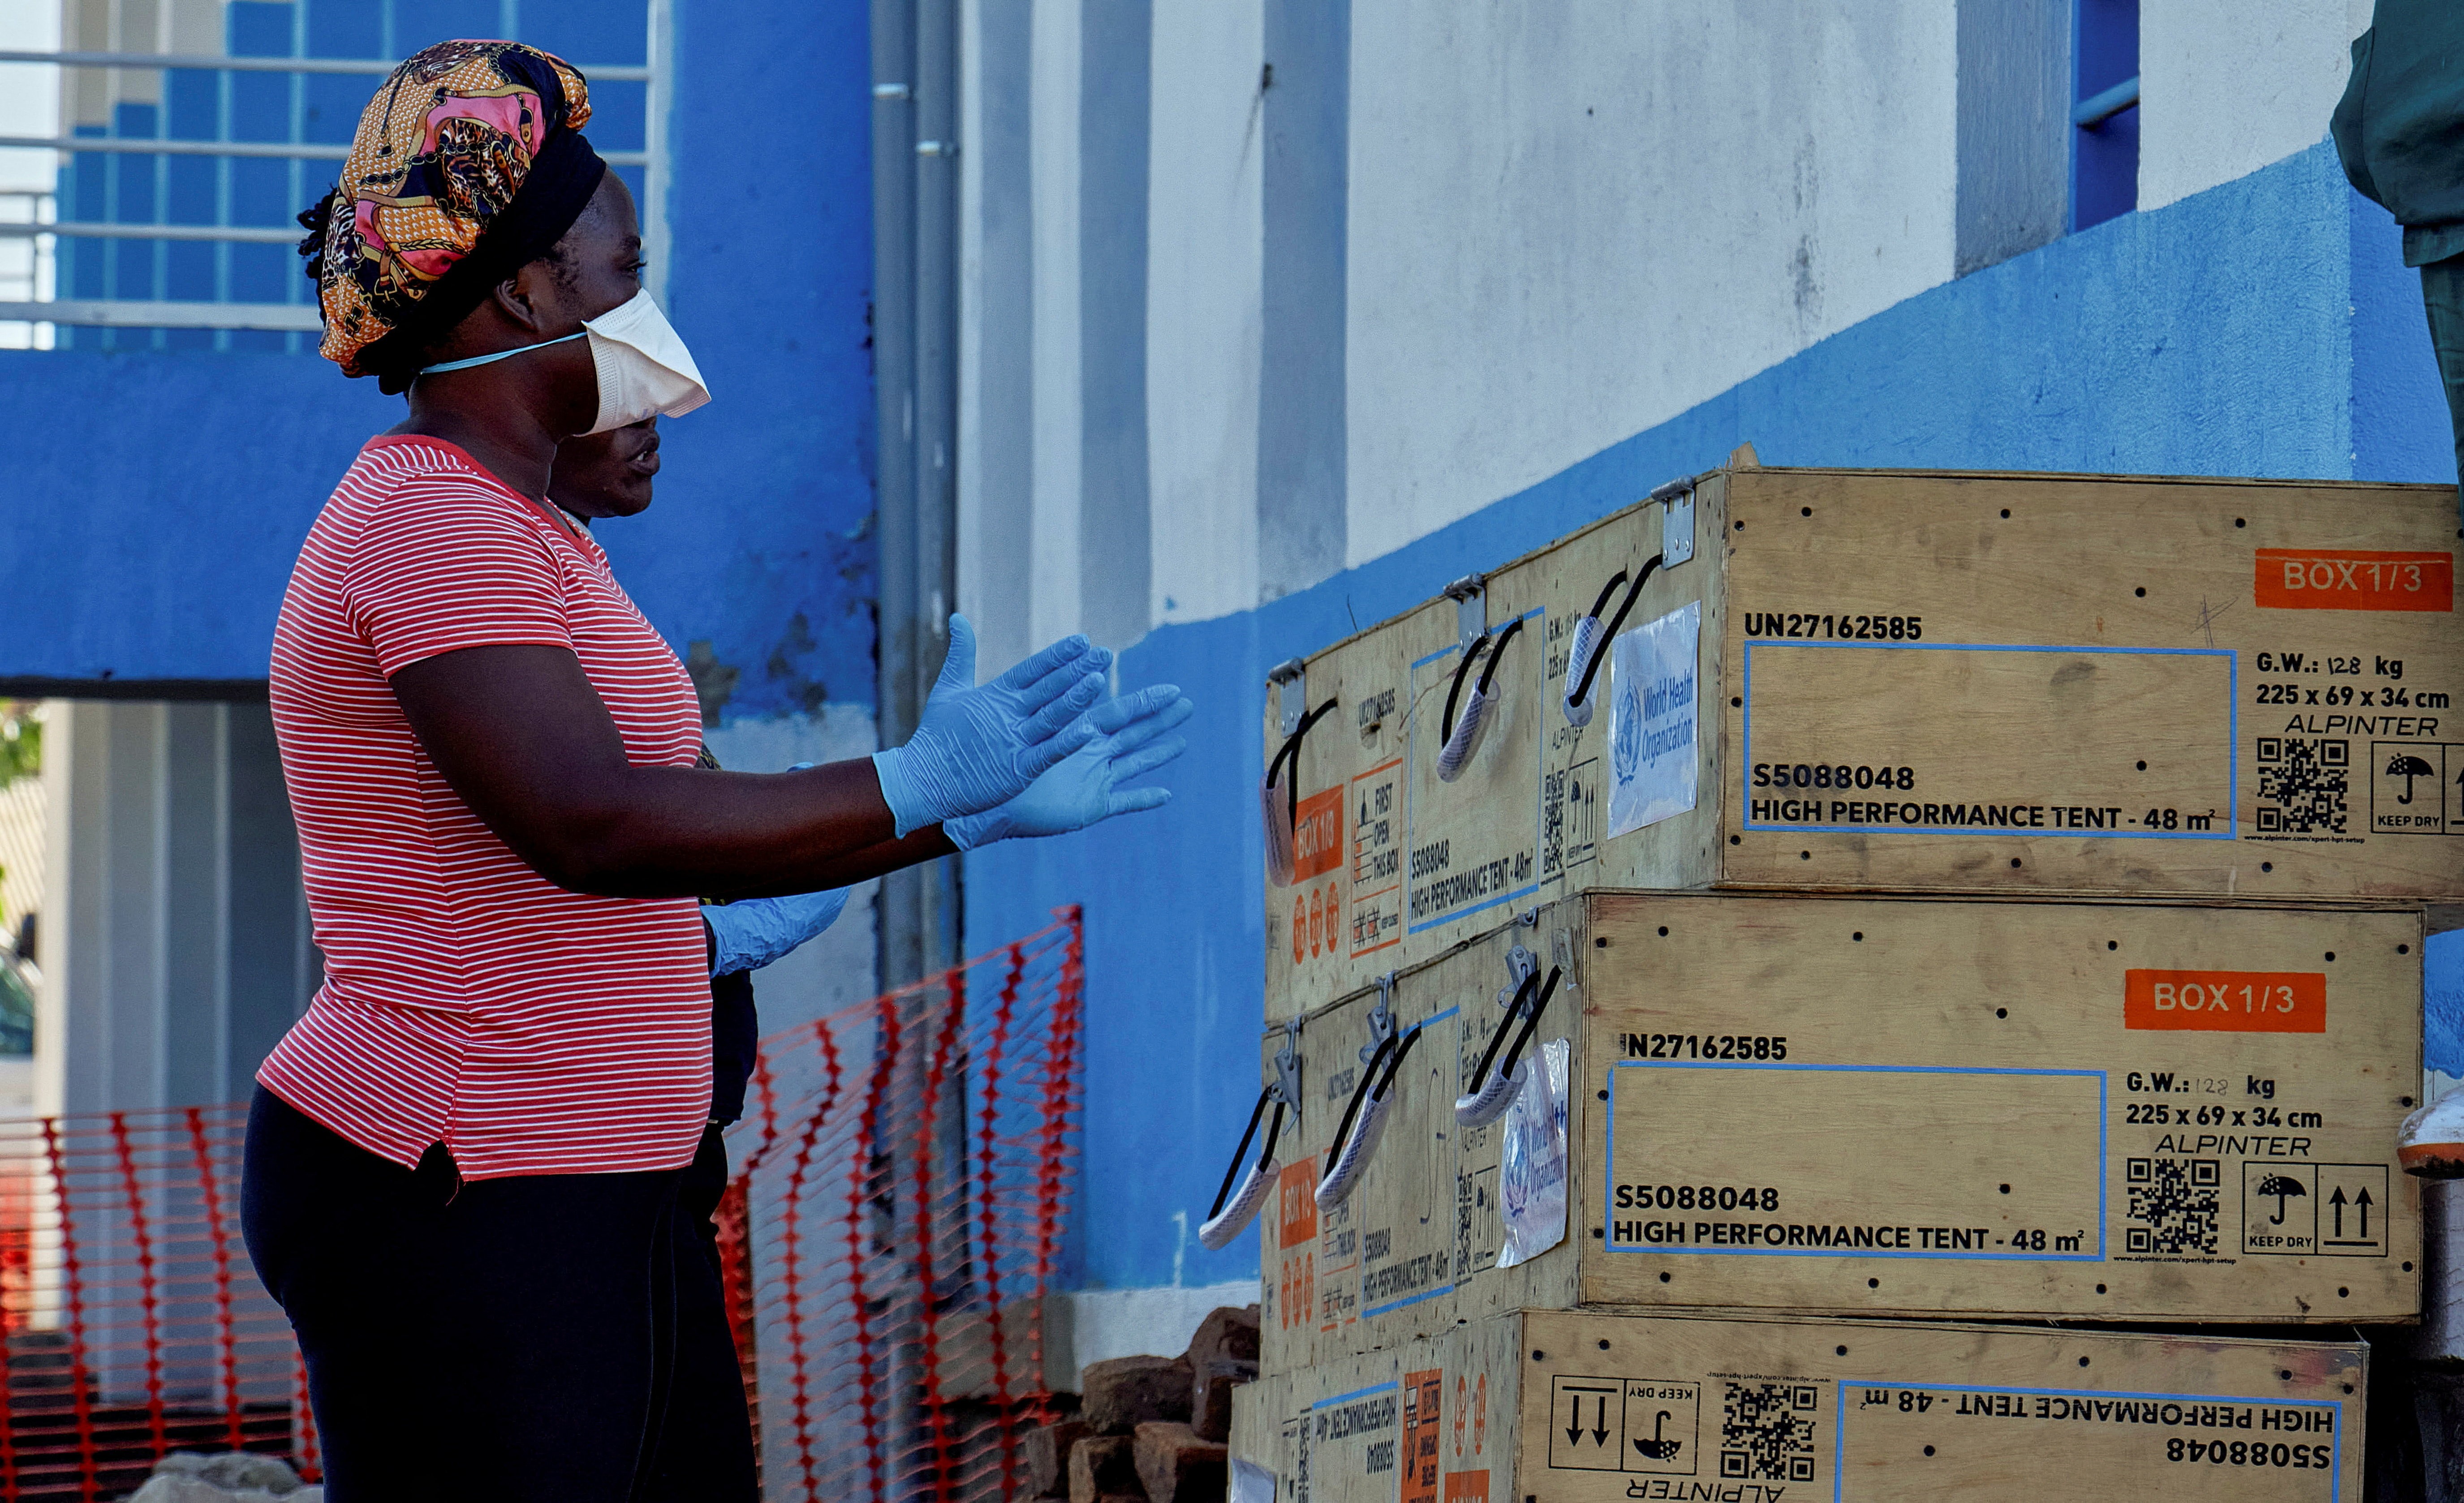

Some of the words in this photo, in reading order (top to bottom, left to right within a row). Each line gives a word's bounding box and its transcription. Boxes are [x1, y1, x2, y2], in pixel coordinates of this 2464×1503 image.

[2284, 561, 2358, 591] BOX
[2367, 563, 2422, 592] 1/3
[1745, 612, 1922, 640] UN27162585
[2257, 652, 2318, 674] G.W.:
[2327, 656, 2361, 675] 128
[2375, 655, 2403, 680] kg
[1643, 677, 1667, 721] World
[1669, 666, 1693, 710] Health
[2256, 683, 2299, 704] 225
[2305, 690, 2319, 706] x
[2325, 686, 2354, 706] 69
[2360, 691, 2375, 707] x
[2381, 687, 2409, 708] 34
[2415, 692, 2450, 709] cm
[2284, 714, 2439, 737] ALPINTER
[1642, 713, 1693, 769] Organization
[1752, 763, 1915, 791] S5088048
[1374, 782, 1393, 815] FIRST
[1751, 799, 1822, 822] HIGH
[1831, 800, 2045, 828] PERFORMANCE
[2050, 806, 2122, 829] TENT
[2144, 808, 2178, 831] 48
[2378, 815, 2412, 827] KEEP
[2415, 816, 2440, 827] DRY
[1297, 816, 1318, 860] BOX
[1374, 819, 1389, 847] OPEN
[1373, 851, 1387, 880] THIS
[1387, 846, 1400, 876] BOX
[1412, 838, 1449, 880] S5088048
[1411, 886, 1430, 920] HIGH
[1431, 864, 1488, 913] PERFORMANCE
[1489, 857, 1509, 892] TENT
[2154, 983, 2230, 1012] BOX
[2239, 985, 2295, 1013] 1/3
[2126, 1071, 2189, 1093] G.W.:
[2196, 1078, 2228, 1096] 128
[2247, 1074, 2275, 1099] kg
[2126, 1104, 2169, 1125] 225
[2175, 1109, 2190, 1125] x
[2196, 1105, 2225, 1126] 69
[2231, 1110, 2246, 1126] x
[2252, 1107, 2282, 1128] 34
[2287, 1112, 2322, 1128] cm
[2154, 1134, 2312, 1157] ALPINTER
[1615, 1184, 1779, 1212] S5088048
[1614, 1220, 1685, 1244] HIGH
[1694, 1222, 1911, 1249] PERFORMANCE
[1917, 1227, 1990, 1250] TENT
[2011, 1229, 2046, 1251] 48
[2249, 1236, 2284, 1247] KEEP
[2287, 1237, 2313, 1248] DRY
[1417, 1254, 1432, 1286] TENT
[2113, 1255, 2237, 1265] www.alpinter.com/xpert-hpt-setup
[1628, 1387, 1655, 1398] DRY
[1658, 1388, 1693, 1400] KEEP
[1898, 1390, 1934, 1413] 48
[1955, 1394, 2029, 1418] TENT
[2033, 1397, 2253, 1430] PERFORMANCE
[2261, 1408, 2333, 1434] HIGH
[1367, 1439, 1394, 1475] S5088048
[2167, 1438, 2331, 1470] S5088048
[1626, 1479, 1786, 1503] ALPINTER
